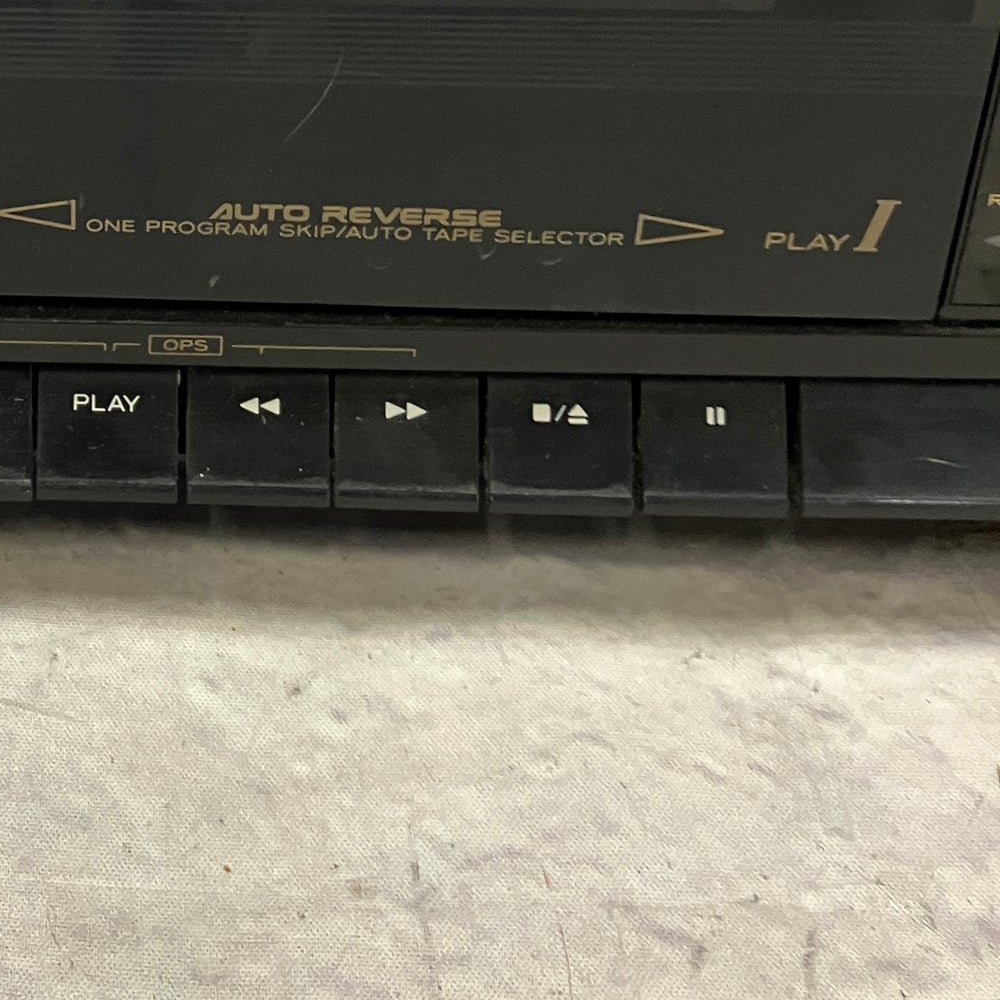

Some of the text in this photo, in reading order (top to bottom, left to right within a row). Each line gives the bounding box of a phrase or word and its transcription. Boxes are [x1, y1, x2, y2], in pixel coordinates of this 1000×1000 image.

[209, 203, 502, 228] AUTO REVERSE
[86, 218, 624, 246] ONE PROGRAM SKIP/AUTO TAPE SELECTOR
[764, 232, 850, 251] PLAY
[162, 338, 209, 353] OPS
[72, 393, 141, 413] PLAY
